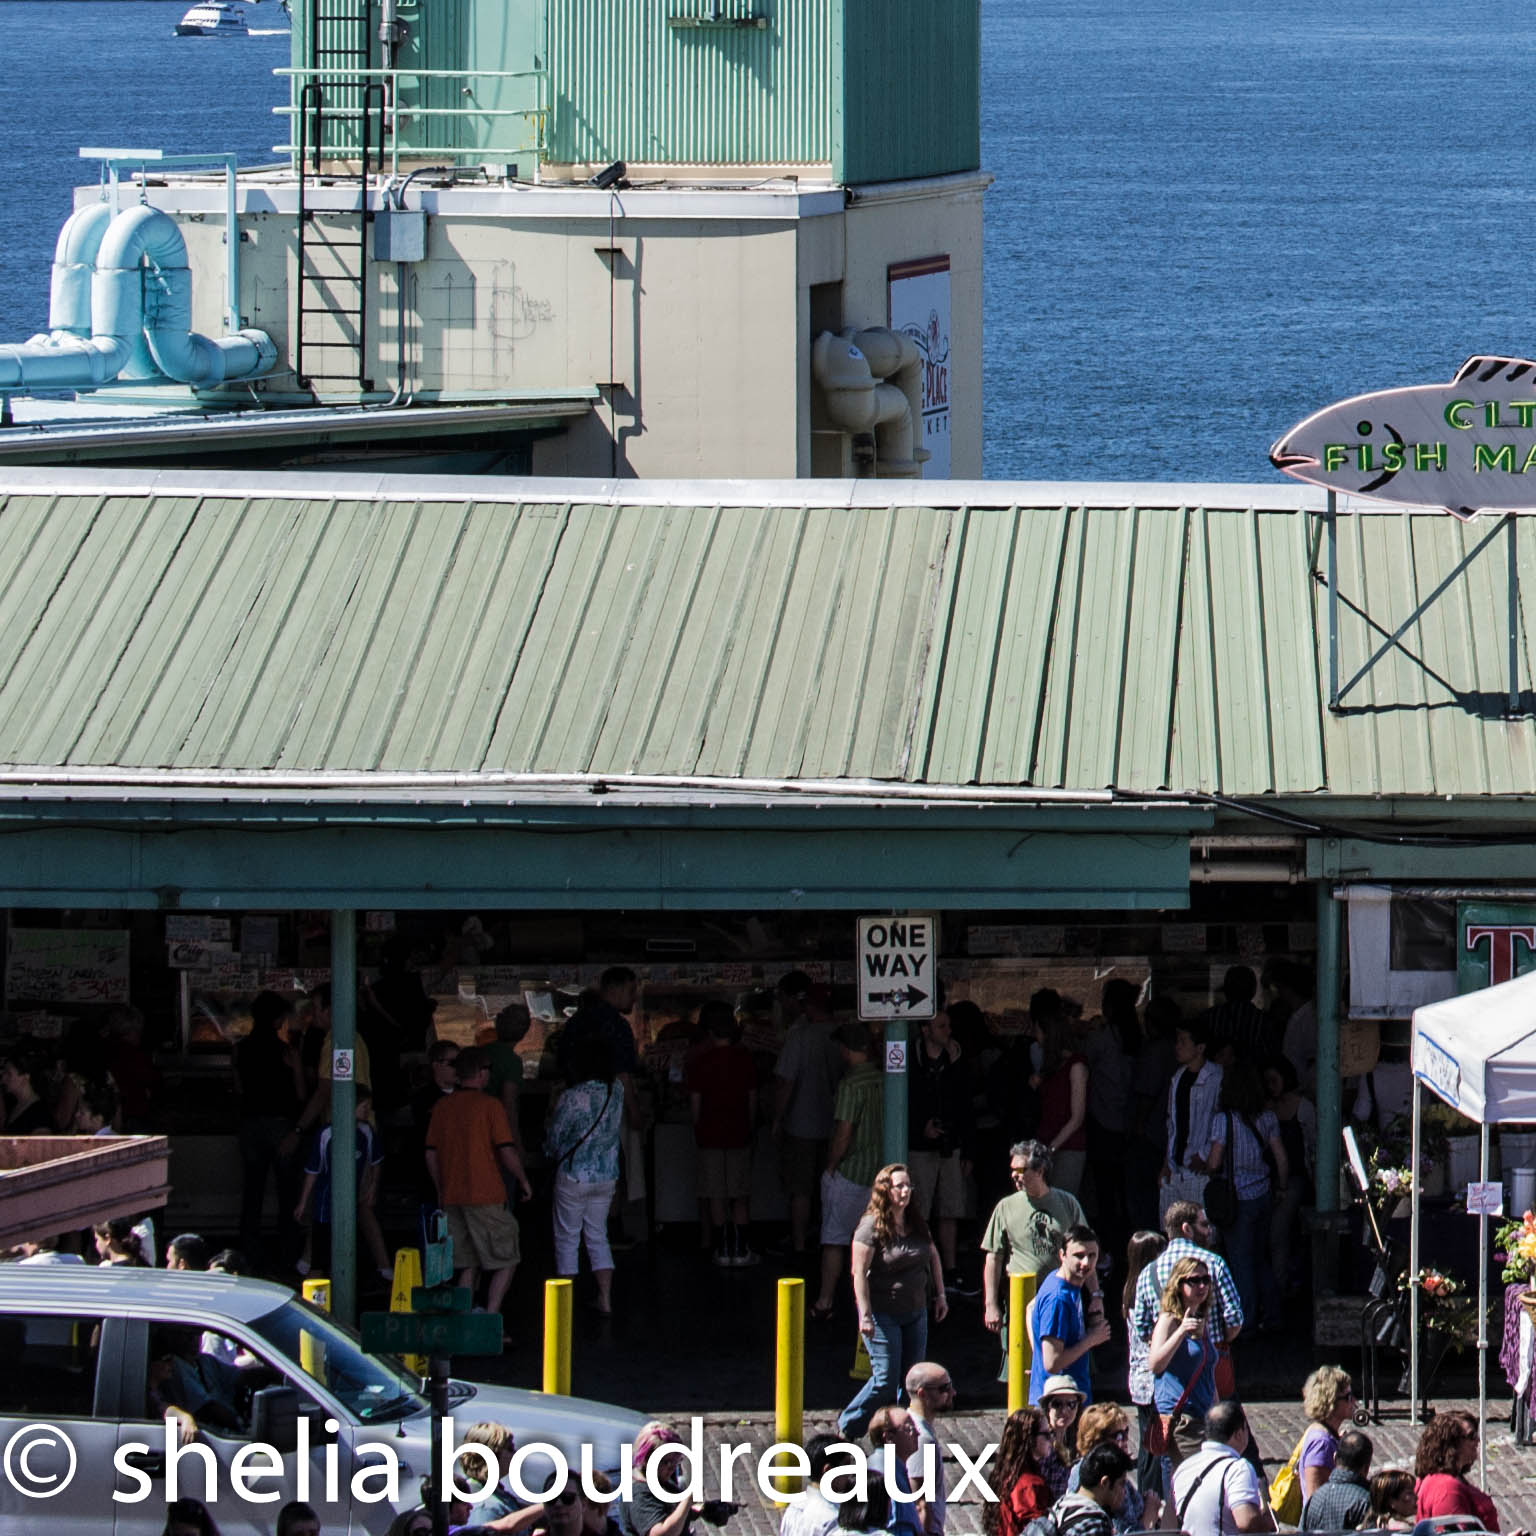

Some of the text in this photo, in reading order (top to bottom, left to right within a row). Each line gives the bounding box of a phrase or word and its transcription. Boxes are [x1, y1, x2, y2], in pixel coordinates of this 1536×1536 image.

[1324, 442, 1447, 472] FISH
[867, 924, 926, 948] ONE
[865, 954, 927, 977] WAY
